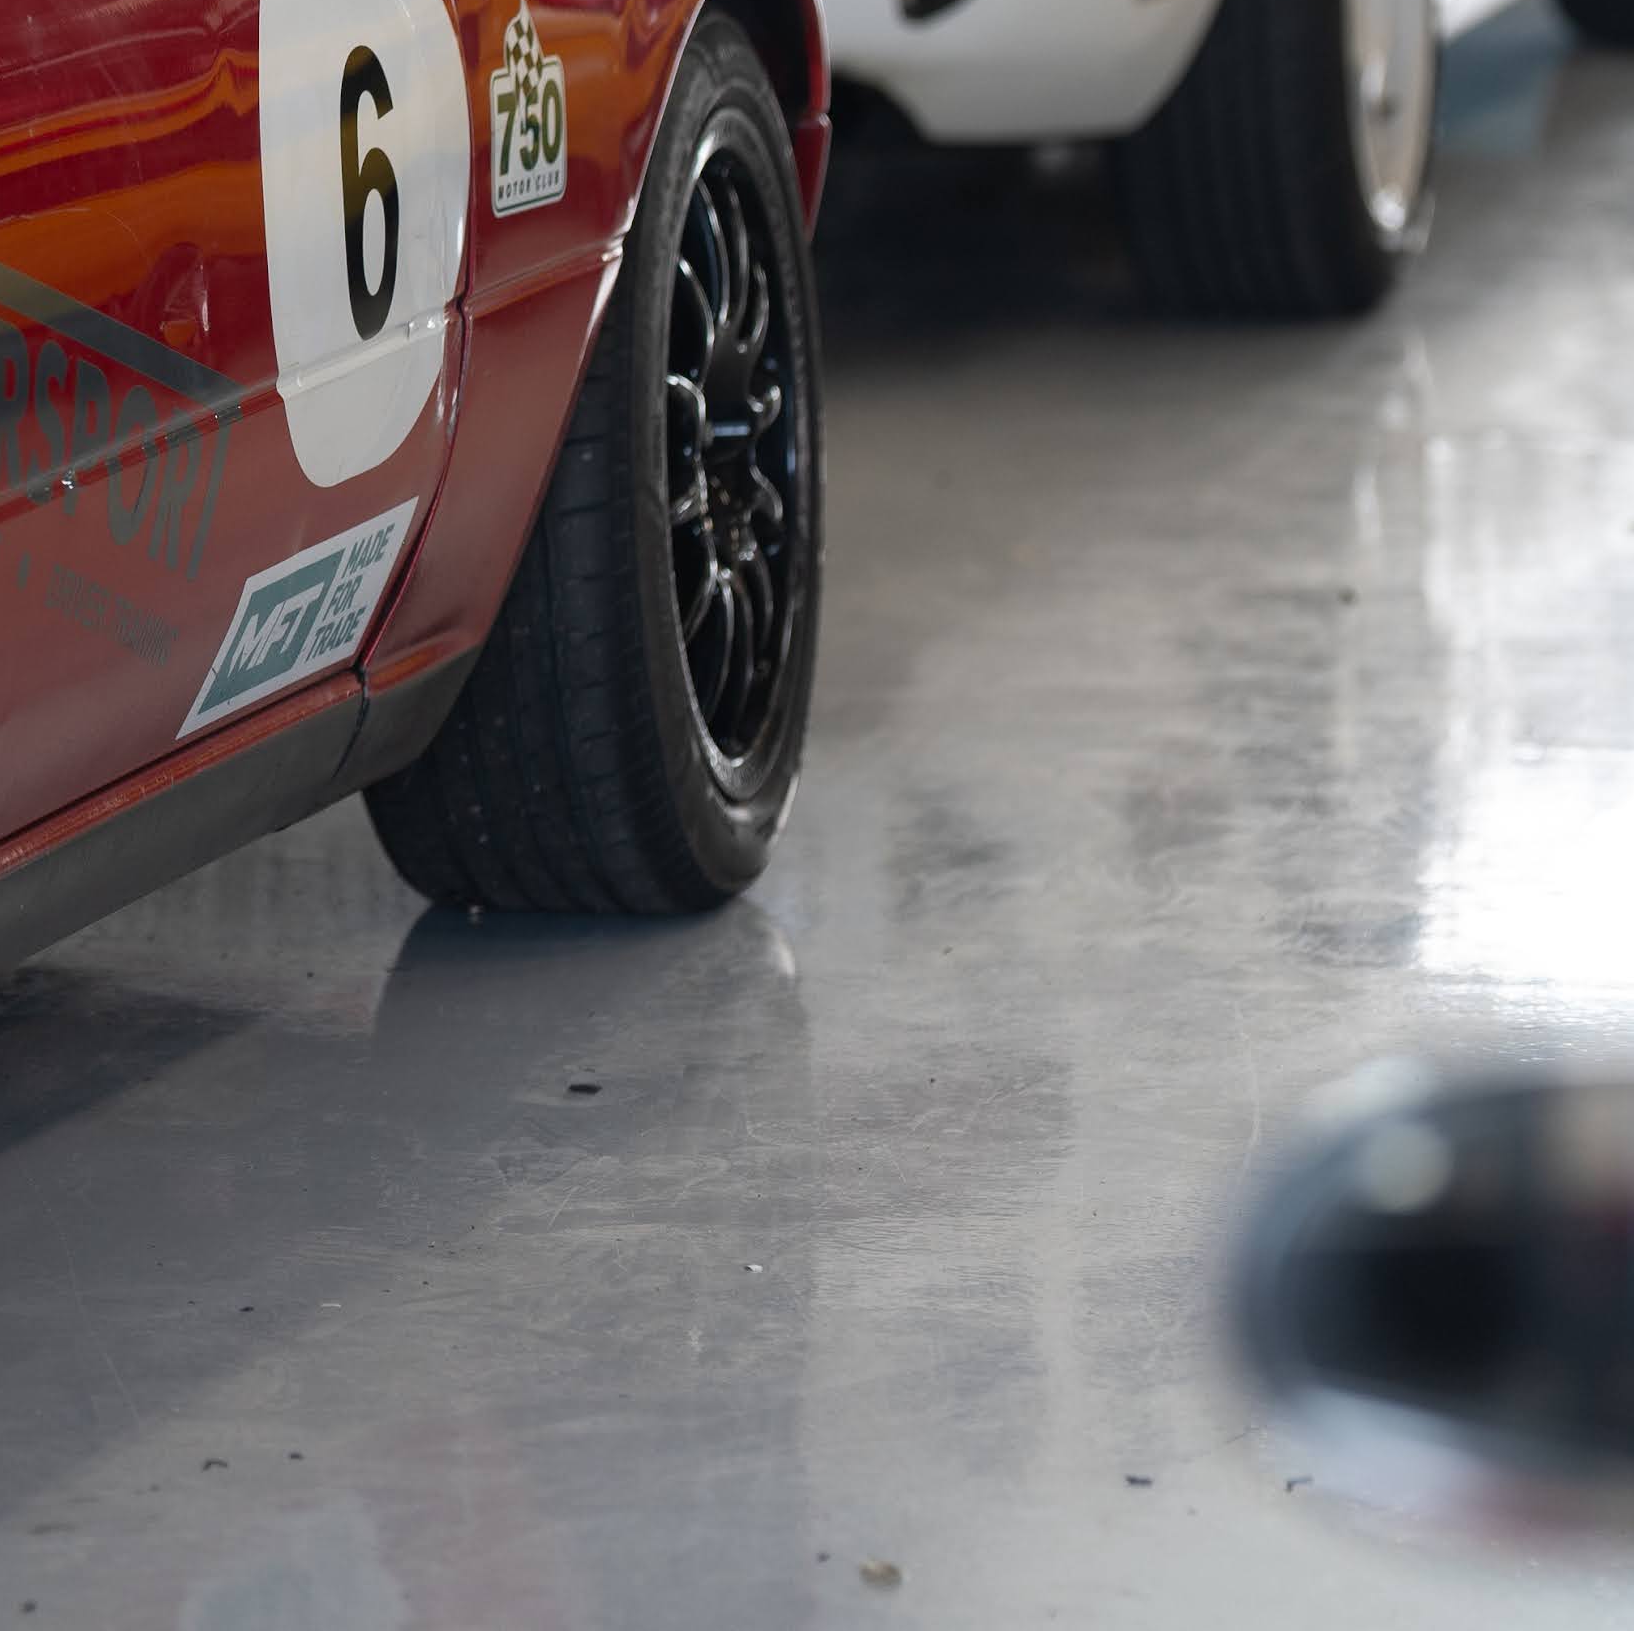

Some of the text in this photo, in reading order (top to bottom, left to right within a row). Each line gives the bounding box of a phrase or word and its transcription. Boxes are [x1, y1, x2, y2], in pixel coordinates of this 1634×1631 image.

[496, 78, 563, 178] 750
[339, 44, 401, 341] 6
[497, 171, 561, 201] MOTOR CLUB
[341, 522, 396, 580] MADE
[322, 575, 364, 623] FOR
[226, 583, 325, 679] MFT
[304, 605, 367, 662] TRADE
